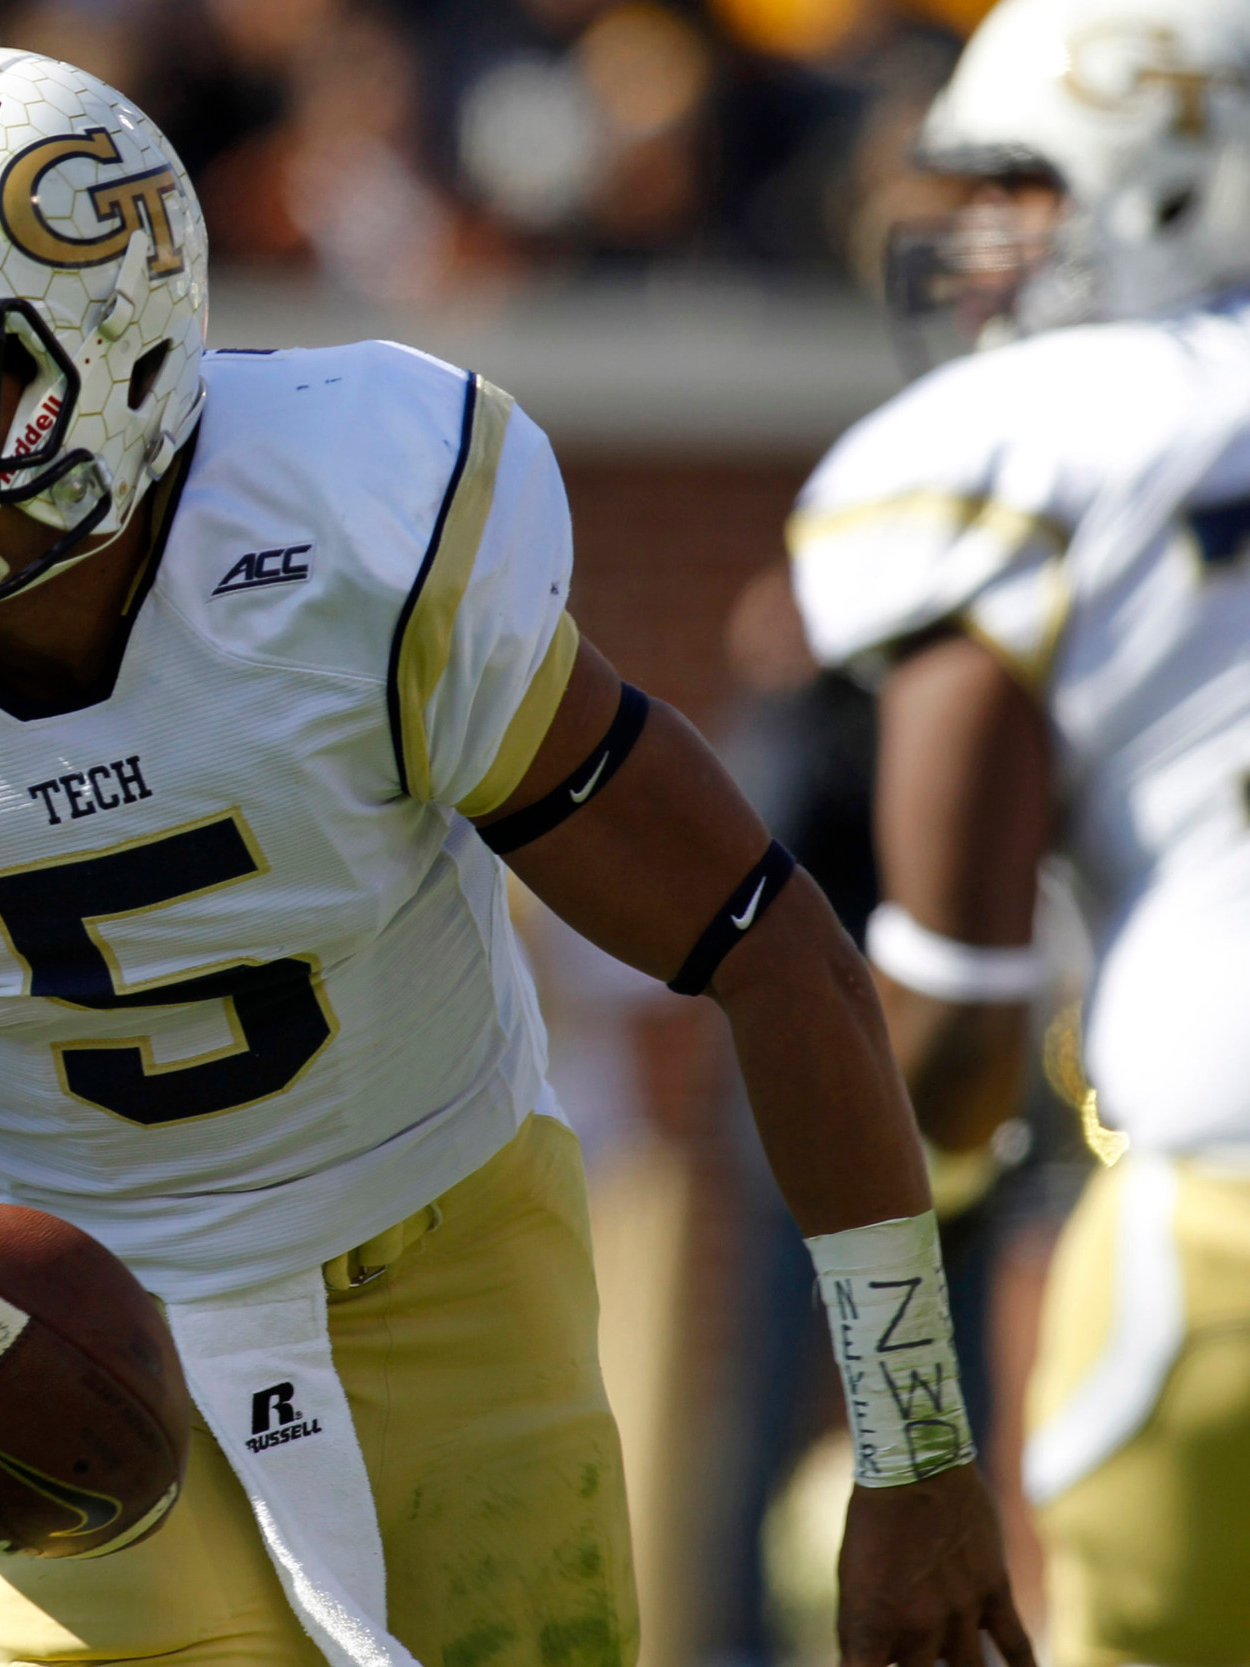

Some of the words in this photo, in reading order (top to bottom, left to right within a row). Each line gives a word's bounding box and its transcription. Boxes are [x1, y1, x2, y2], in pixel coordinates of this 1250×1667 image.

[218, 544, 312, 587] ACC
[28, 755, 152, 825] TECH
[245, 1418, 322, 1453] RUSSELL
